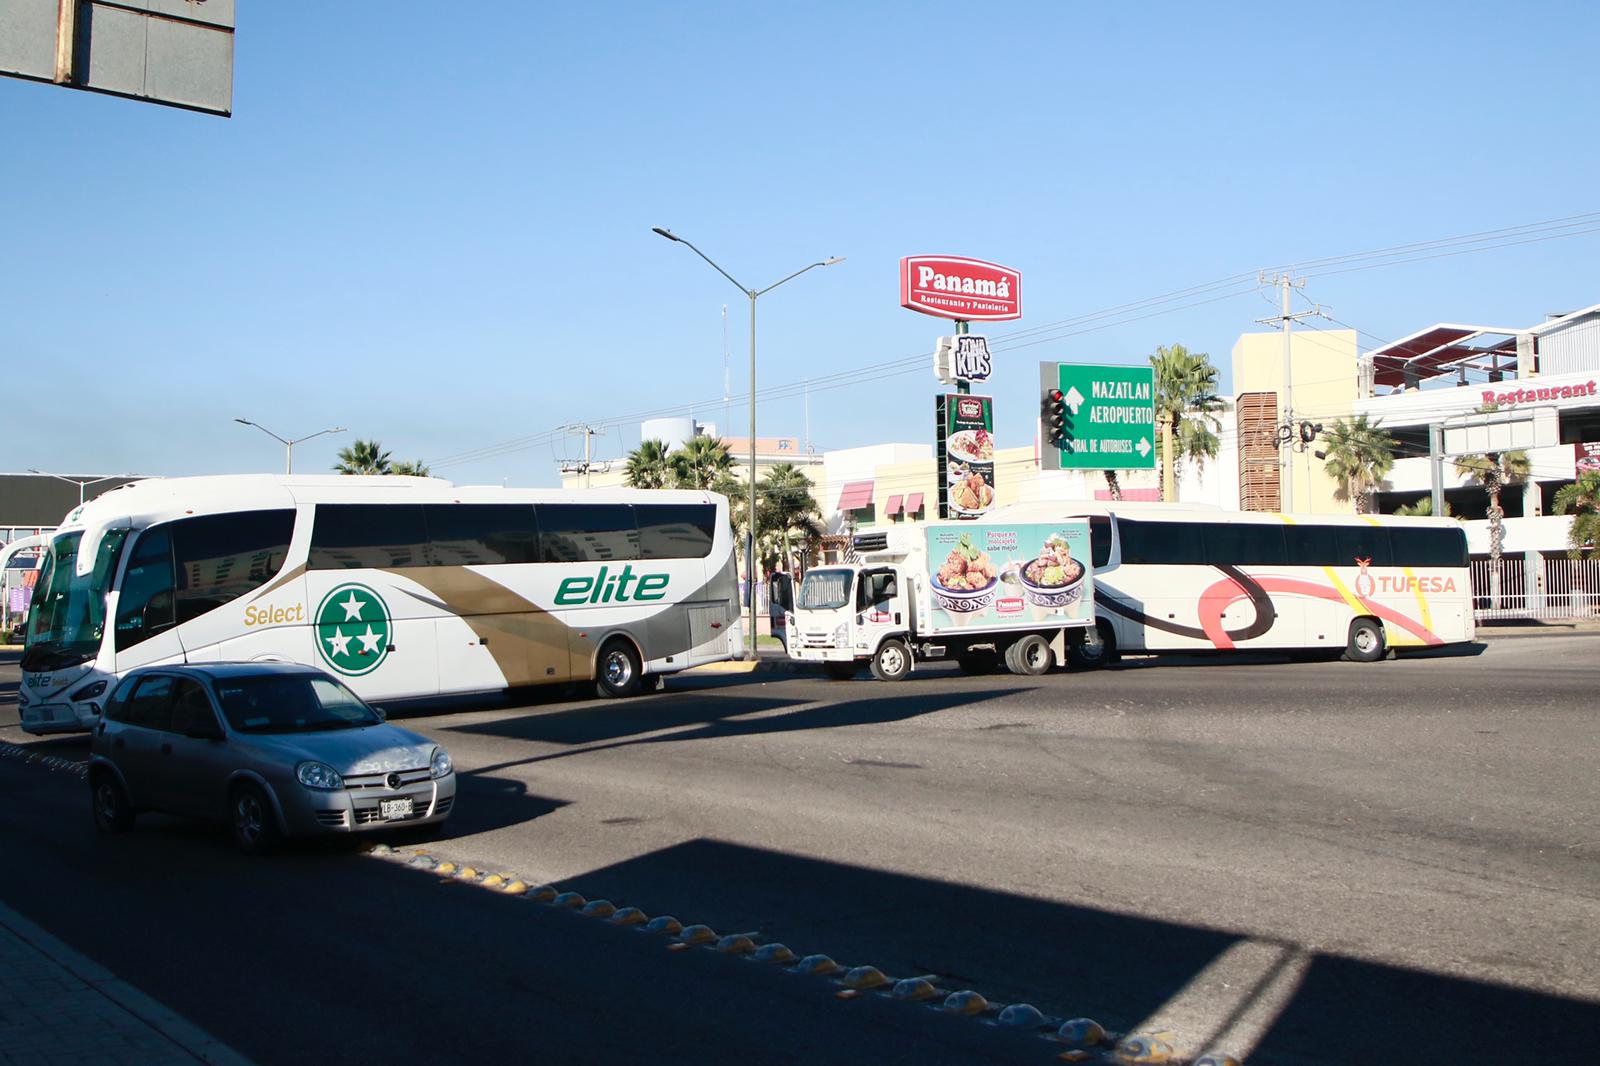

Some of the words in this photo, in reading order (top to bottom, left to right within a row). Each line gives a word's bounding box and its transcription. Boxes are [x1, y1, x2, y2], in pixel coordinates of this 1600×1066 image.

[917, 266, 1010, 297] Panamá
[921, 295, 964, 307] Restaurante
[966, 301, 972, 309] y
[959, 338, 985, 353] ZONA
[1092, 381, 1150, 400] MAZATLAN
[1482, 380, 1597, 406] Restaurant
[1089, 406, 1153, 424] AEROPUERTO
[1090, 439, 1098, 453] DE
[1100, 439, 1132, 453] AUTOBUSES
[1002, 544, 1018, 552] mejor
[553, 564, 670, 605] elite
[1378, 576, 1456, 593] TUFESA
[244, 602, 304, 626] Select
